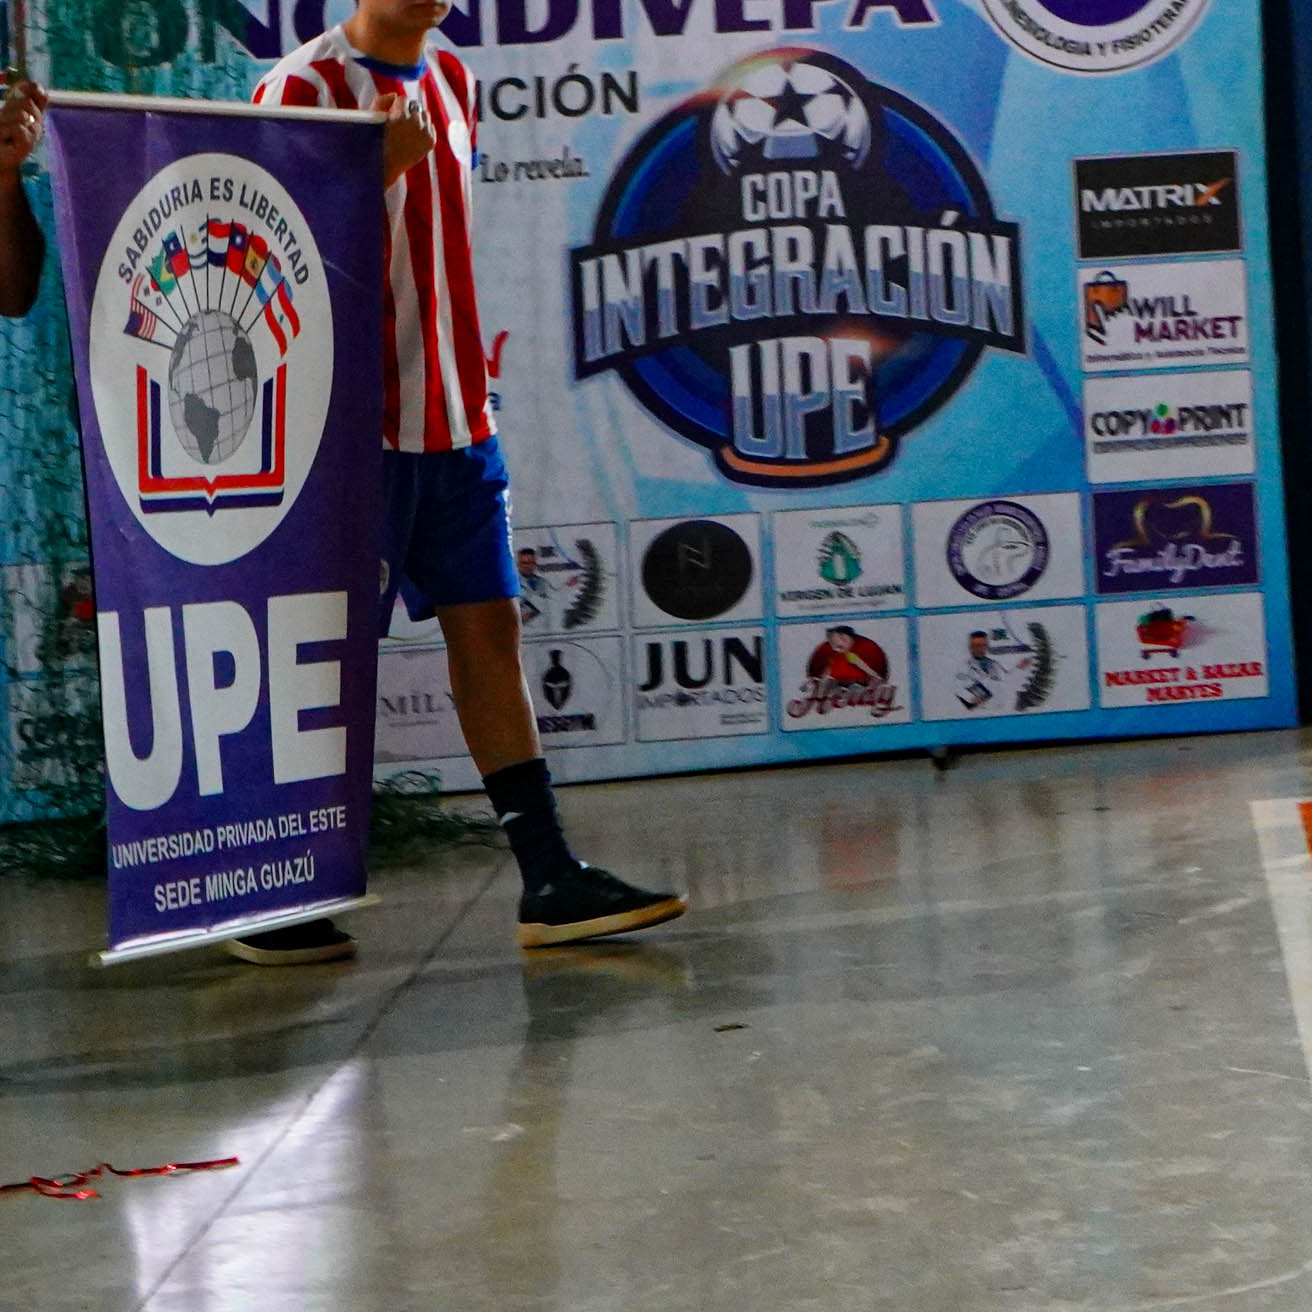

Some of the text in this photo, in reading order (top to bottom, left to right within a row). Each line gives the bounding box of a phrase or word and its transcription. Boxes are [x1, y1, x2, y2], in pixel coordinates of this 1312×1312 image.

[1096, 41, 1108, 57] Y
[741, 170, 846, 222] COPA
[1081, 177, 1232, 212] MATRIX
[118, 177, 309, 286] SABIDURIA ES LIBERTAD
[580, 210, 1015, 364] INTEGRACIÓN
[1133, 294, 1198, 319] WILL
[1133, 316, 1243, 343] MARKET
[729, 335, 877, 460] UPE
[1091, 409, 1152, 436] COPY
[640, 637, 764, 692] JUN
[97, 591, 348, 811] UPE
[112, 805, 346, 869] UNIVERSIDAD PRIVADA DEL ESTE
[154, 848, 315, 912] SEDE MINGA GUAZÚ
